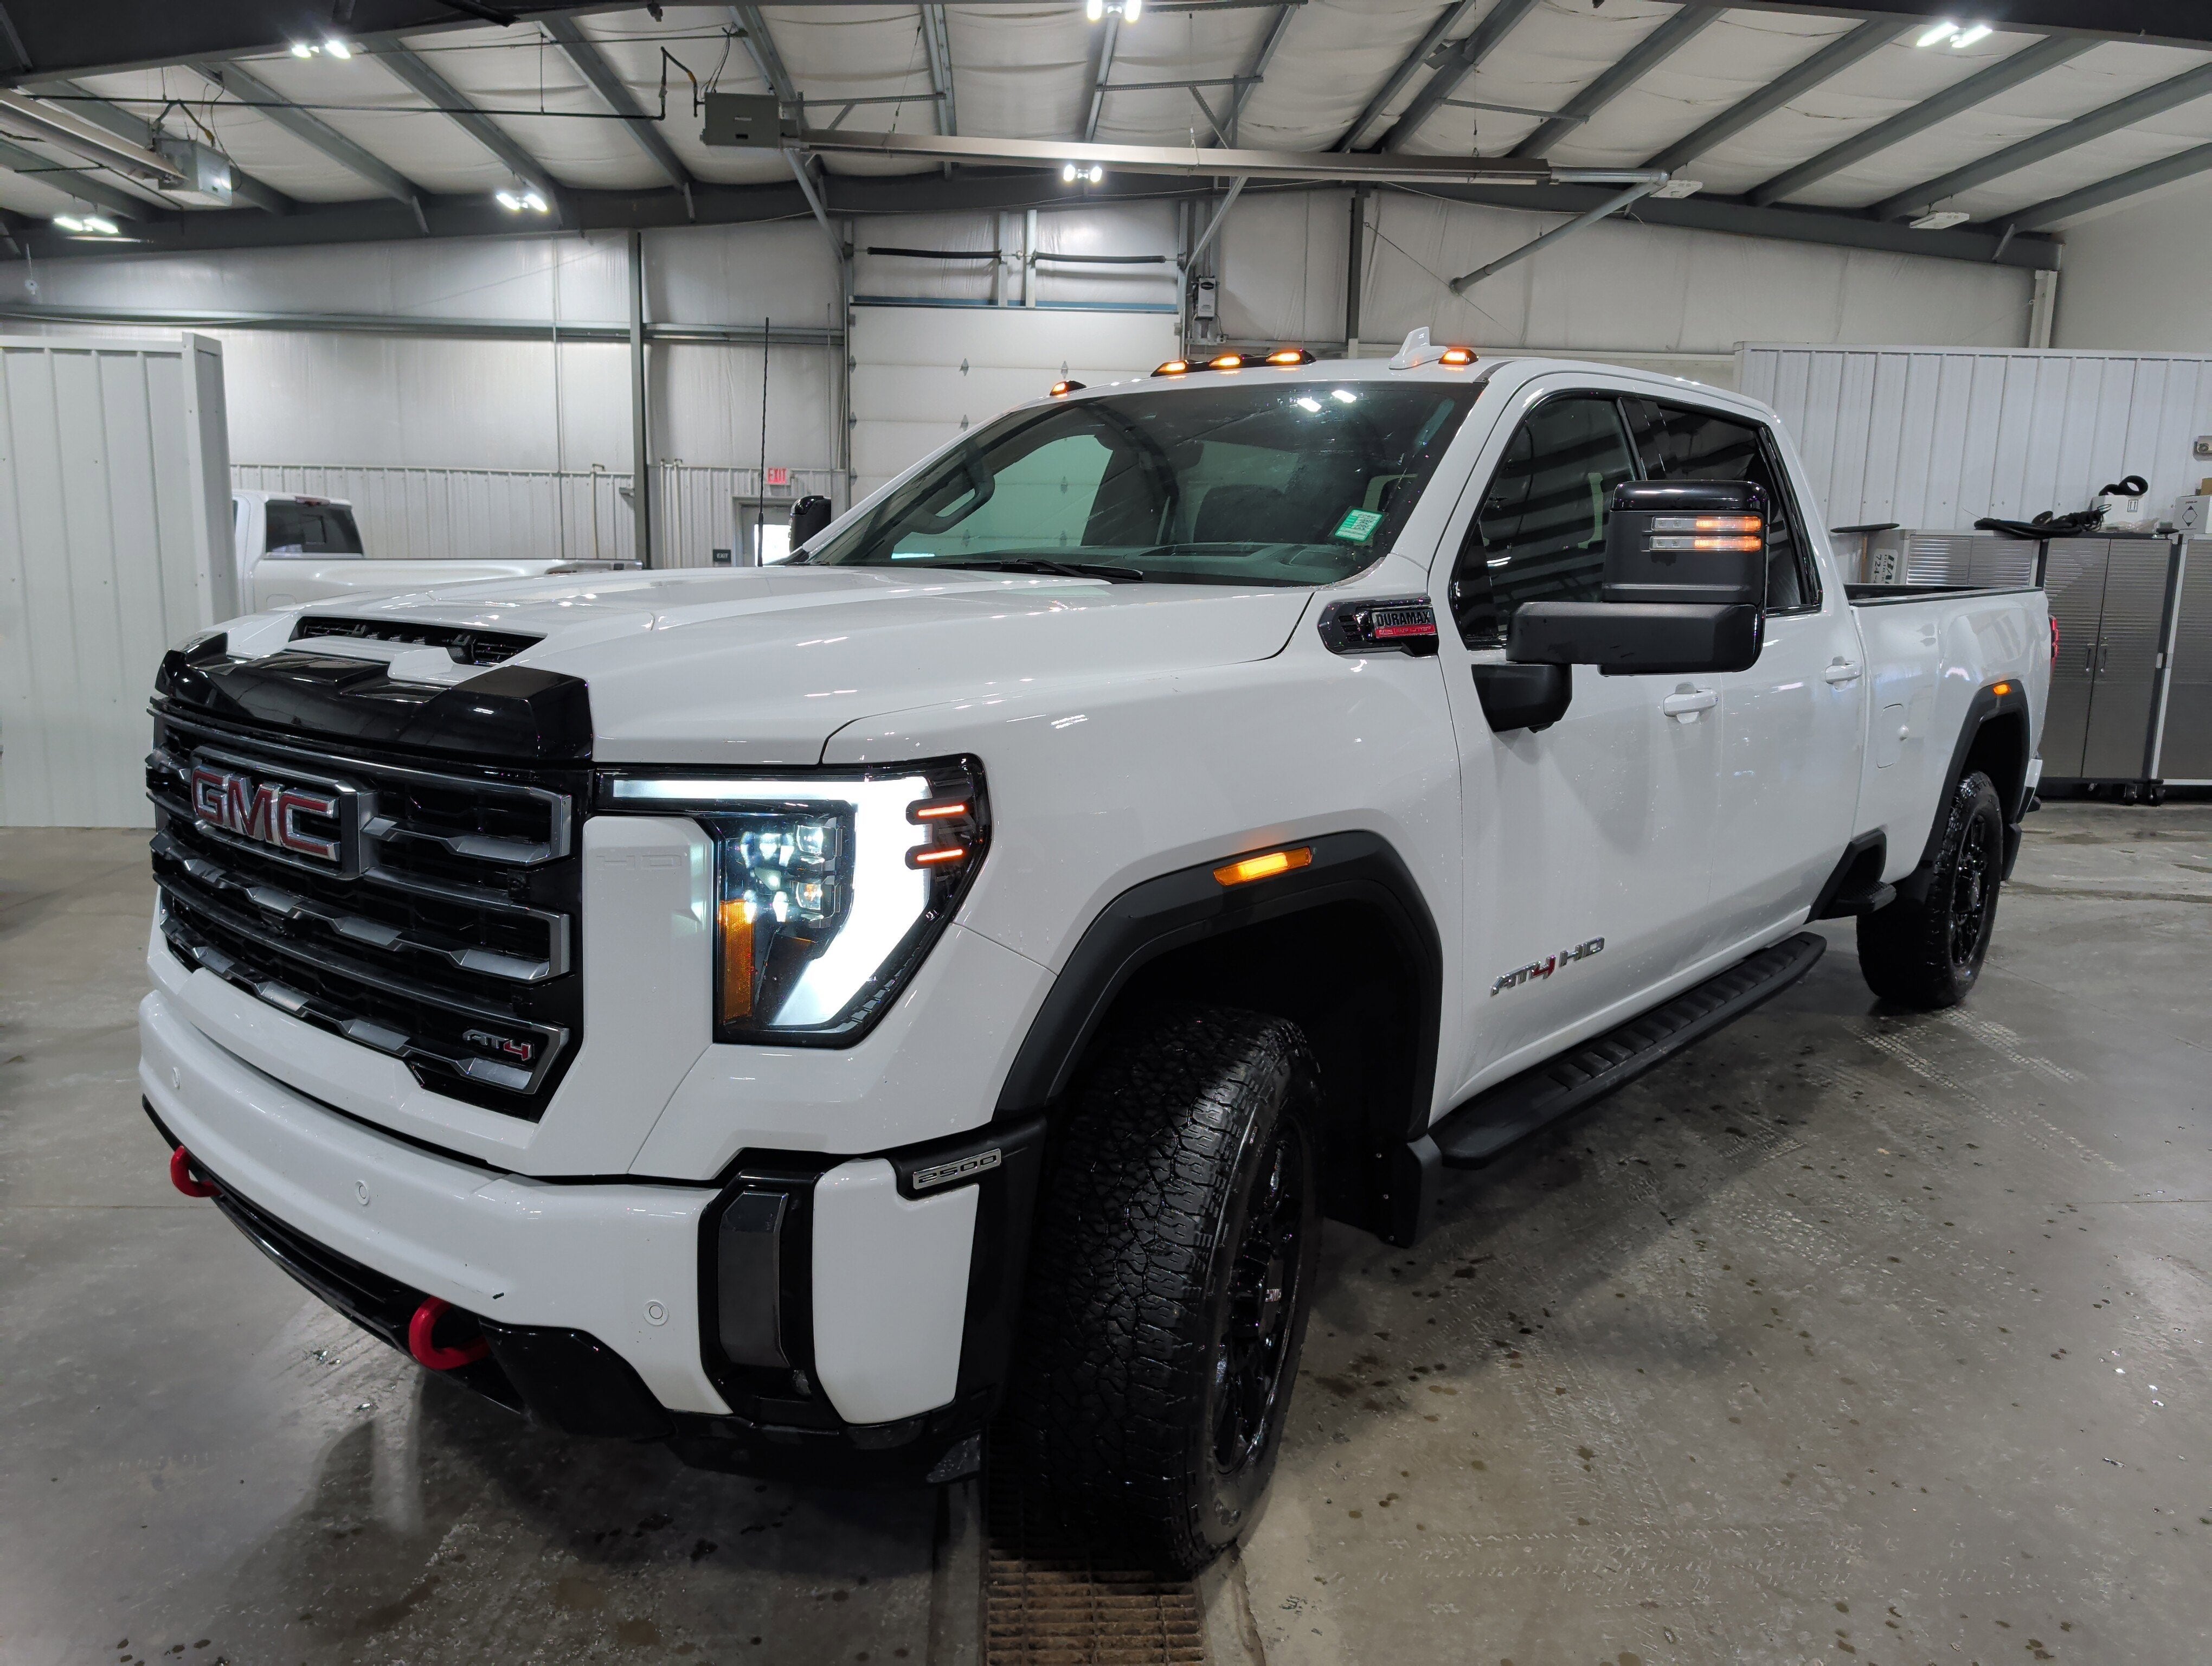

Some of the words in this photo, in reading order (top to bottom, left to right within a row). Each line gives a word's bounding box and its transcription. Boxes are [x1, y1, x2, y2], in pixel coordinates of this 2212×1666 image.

[768, 467, 786, 483] EXIT
[1874, 554, 1882, 584] 724-
[1375, 610, 1431, 627] DURAMAX
[191, 765, 342, 862] GMC
[595, 855, 681, 870] HD
[1490, 954, 1556, 997] AT4
[1559, 936, 1605, 967] HD
[462, 1029, 533, 1061] AT4
[918, 1155, 997, 1184] 2500
